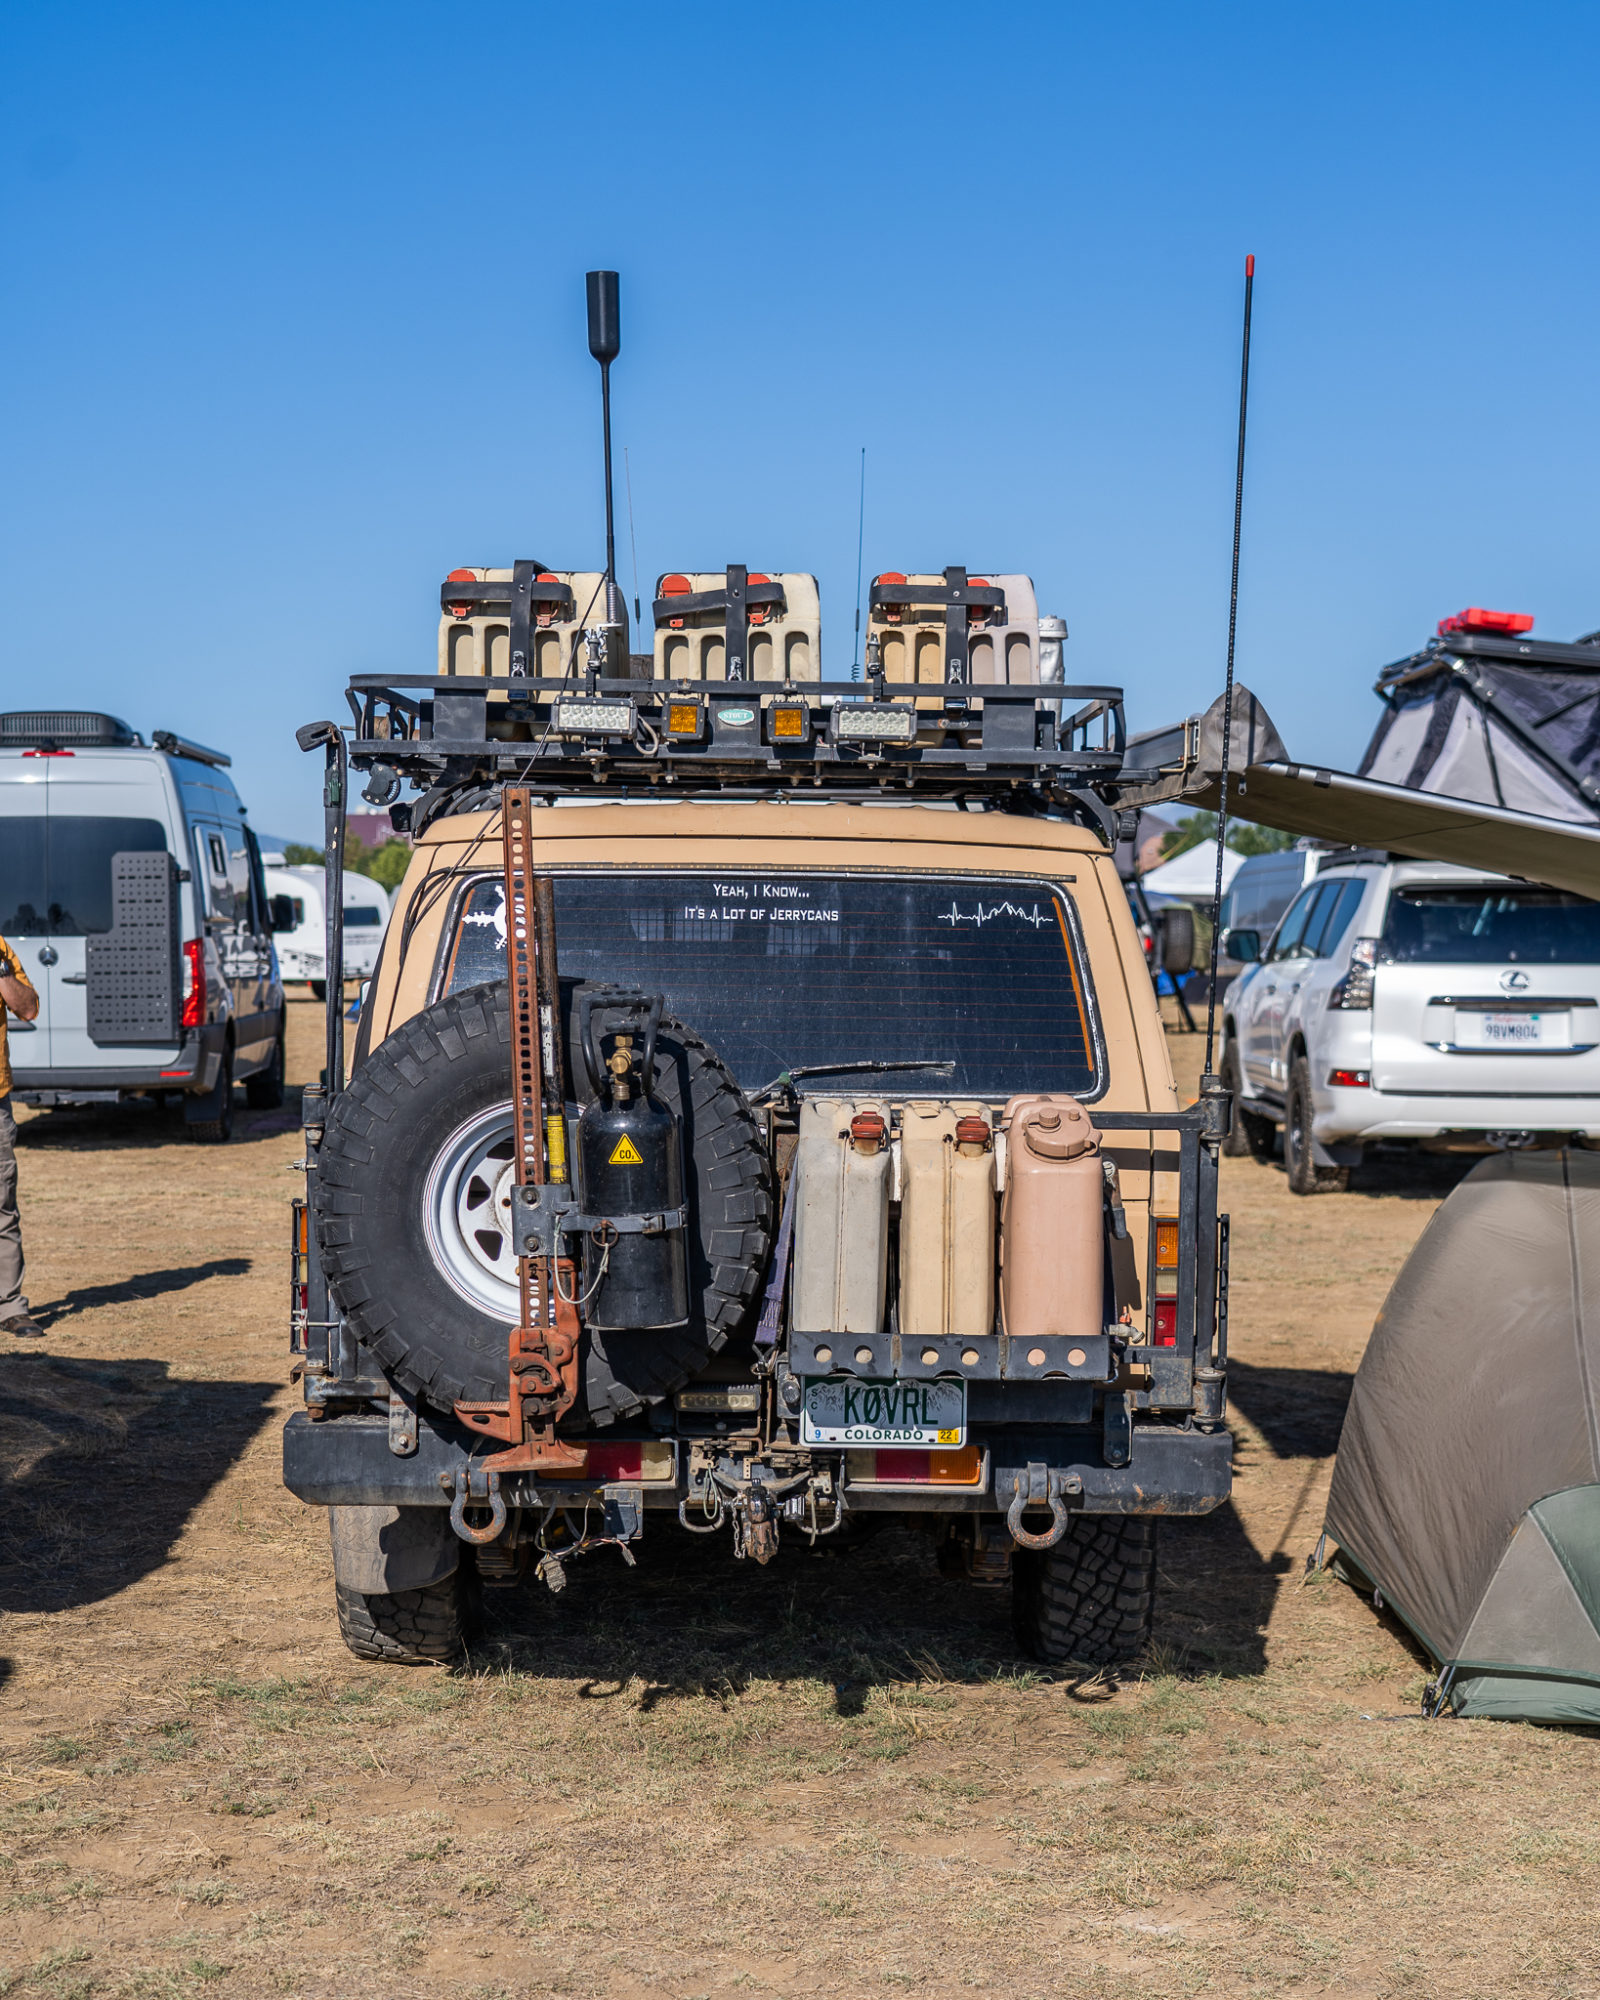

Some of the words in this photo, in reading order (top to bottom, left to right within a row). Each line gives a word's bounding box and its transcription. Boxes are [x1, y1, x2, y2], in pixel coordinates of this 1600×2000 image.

[753, 885, 758, 897] I
[814, 1429, 822, 1439] 9
[844, 1429, 924, 1440] COLORADO
[940, 1431, 953, 1440] 22
